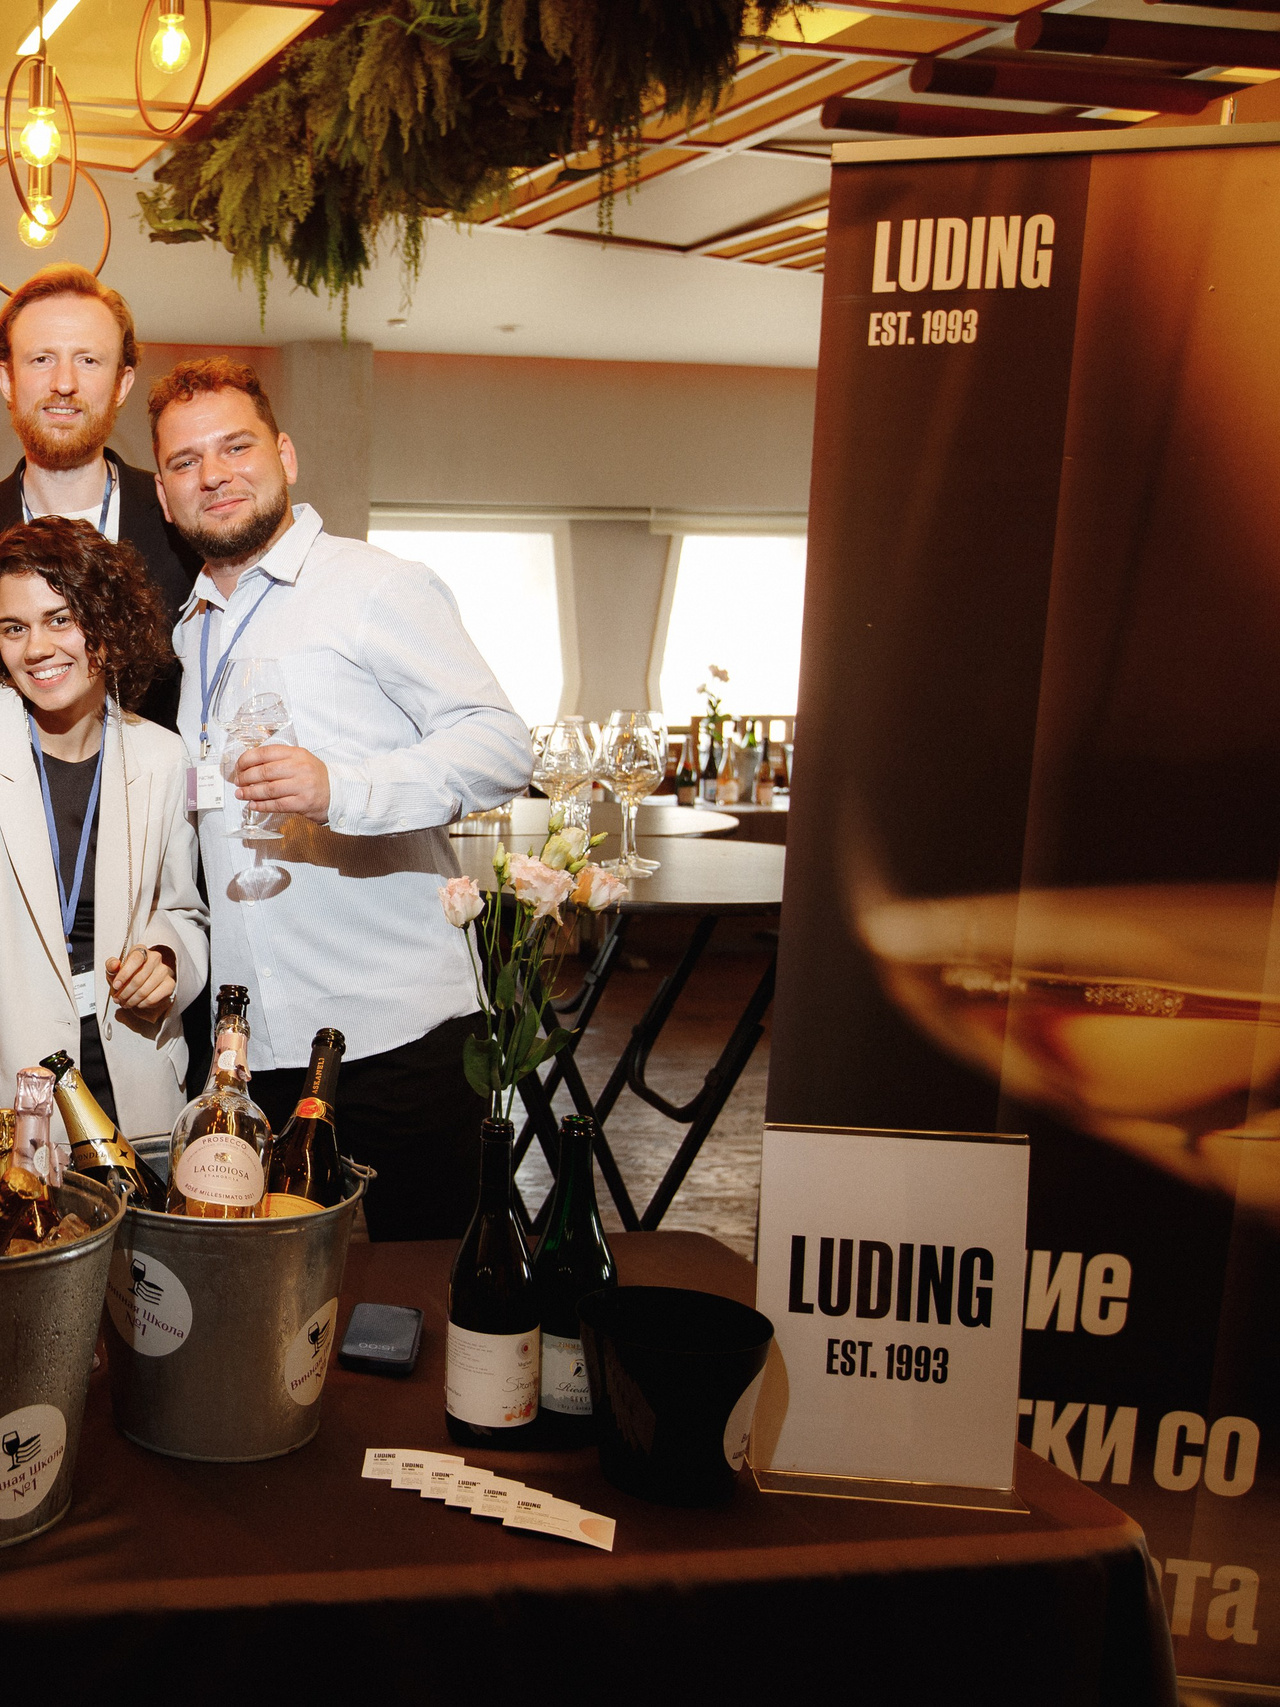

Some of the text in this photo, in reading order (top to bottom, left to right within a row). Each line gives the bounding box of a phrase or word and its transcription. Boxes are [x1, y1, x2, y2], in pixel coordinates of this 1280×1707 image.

[871, 214, 1056, 293] LUDING
[867, 309, 979, 346] EST. 1993
[202, 1136, 247, 1150] PROSECCO
[199, 1189, 243, 1200] MILLESIMATO
[787, 1235, 995, 1329] LUDING
[1023, 1248, 1132, 1336] ие
[125, 1310, 147, 1336] №1
[142, 1308, 184, 1339] Школа
[825, 1338, 950, 1384] EST. 1993
[29, 1445, 64, 1476] Школа
[1152, 1410, 1261, 1497] со
[12, 1477, 37, 1502] №1
[484, 1488, 508, 1497] LUDING
[517, 1500, 542, 1509] LUDING
[1149, 1555, 1261, 1645] та
